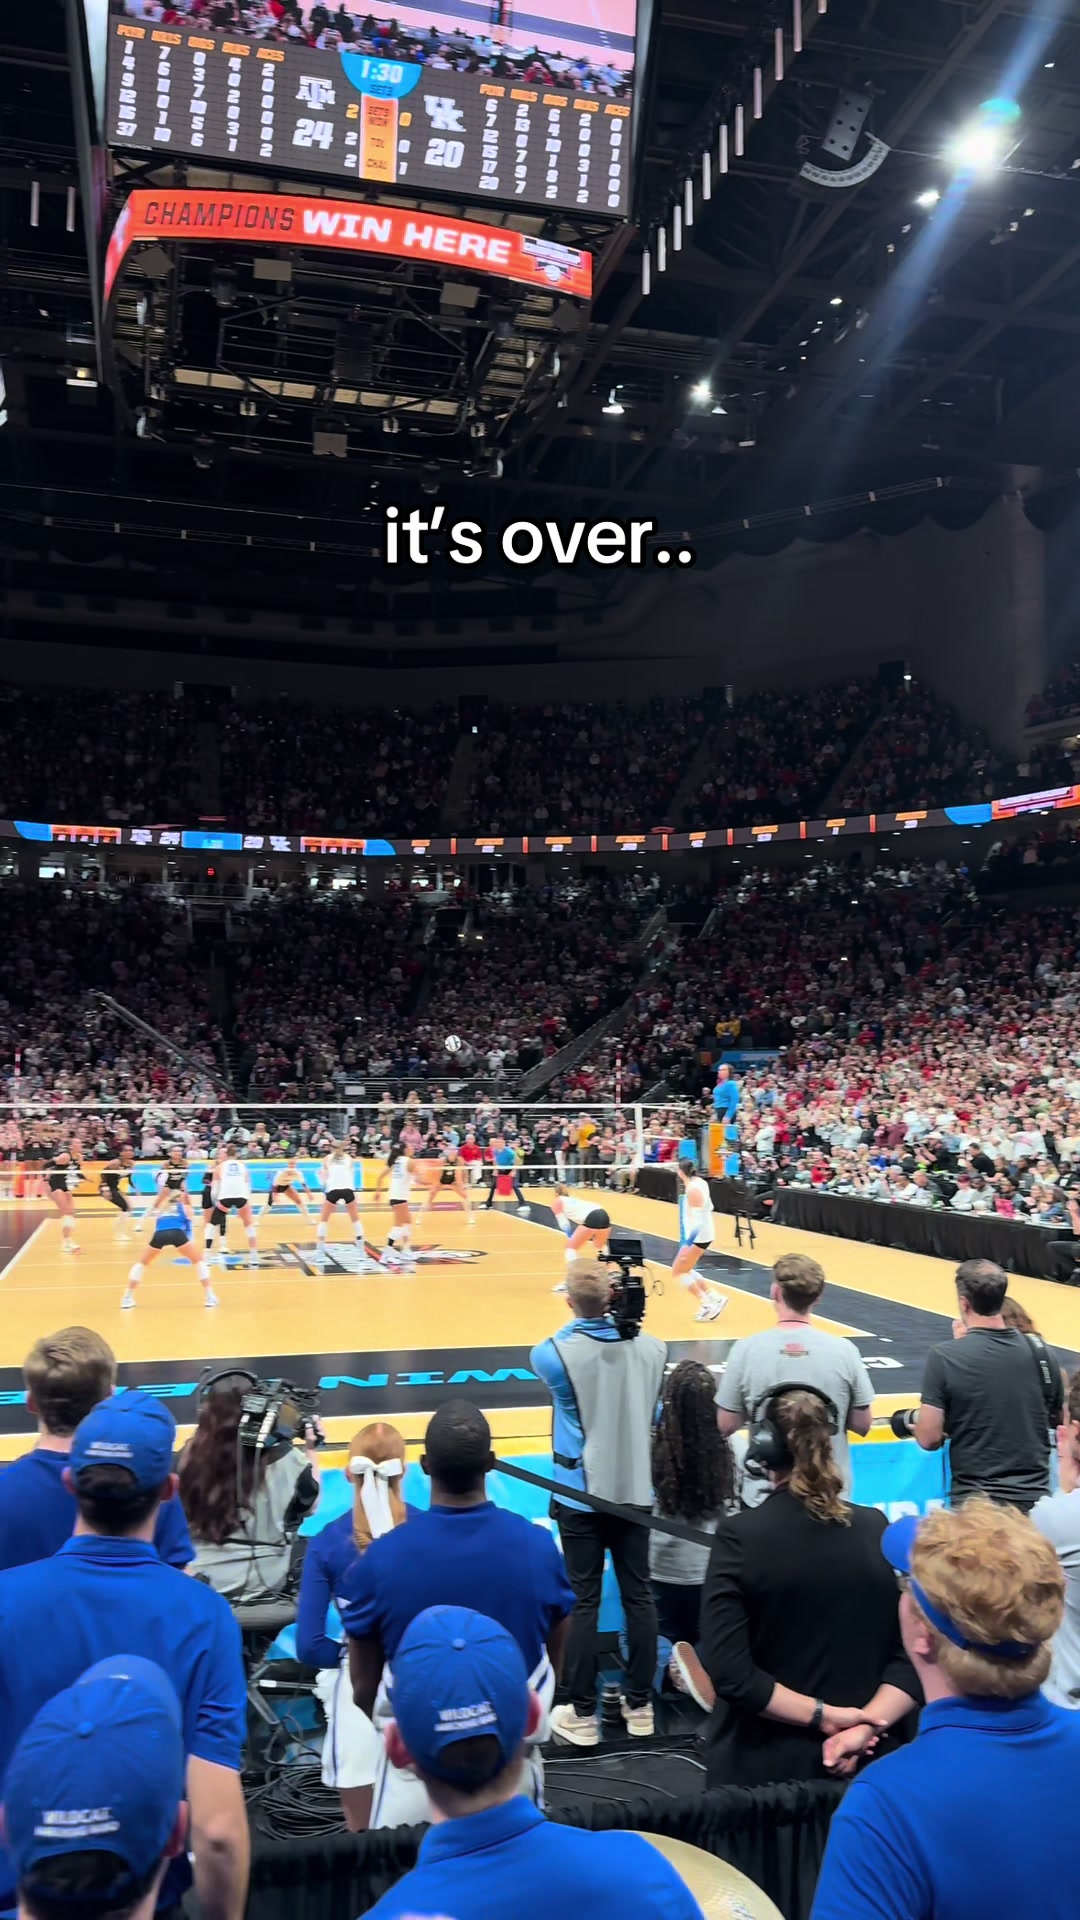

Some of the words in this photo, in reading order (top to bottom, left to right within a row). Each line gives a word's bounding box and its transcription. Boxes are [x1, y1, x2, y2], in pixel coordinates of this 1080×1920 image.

[124, 40, 134, 54] 1
[159, 46, 171, 59] 7
[262, 63, 275, 77] 2
[157, 62, 171, 76] 6
[192, 67, 205, 81] 3
[361, 59, 403, 83] 1:30
[119, 89, 137, 104] 12
[121, 73, 135, 87] 9
[192, 84, 205, 97] 7
[227, 89, 240, 104] 2
[158, 111, 168, 125] 1
[191, 116, 204, 130] 5
[226, 121, 239, 135] 3
[345, 104, 359, 119] 2
[485, 99, 498, 112] 6
[516, 104, 529, 117] 2
[548, 109, 560, 122] 6
[579, 113, 592, 127] 2
[486, 113, 498, 127] 7
[515, 118, 531, 132] 13
[116, 122, 138, 137] 37
[191, 132, 204, 147] 6
[228, 138, 238, 152] 1
[259, 143, 273, 157] 2
[292, 118, 334, 149] 24
[345, 131, 358, 145] 2
[483, 129, 499, 144] 12
[611, 148, 620, 161] 1
[344, 154, 357, 168] 2
[424, 138, 465, 168] 20
[516, 149, 528, 162] 7
[549, 154, 558, 167] 1
[577, 159, 590, 172] 3
[399, 161, 408, 175] 1
[482, 160, 498, 173] 17
[514, 165, 527, 178] 9
[579, 174, 588, 187] 1
[515, 181, 527, 193] 7
[545, 185, 558, 199] 2
[576, 189, 589, 203] 2
[144, 202, 295, 231] CHAMPIONS
[304, 210, 393, 243] WIN
[403, 222, 512, 265] HERE
